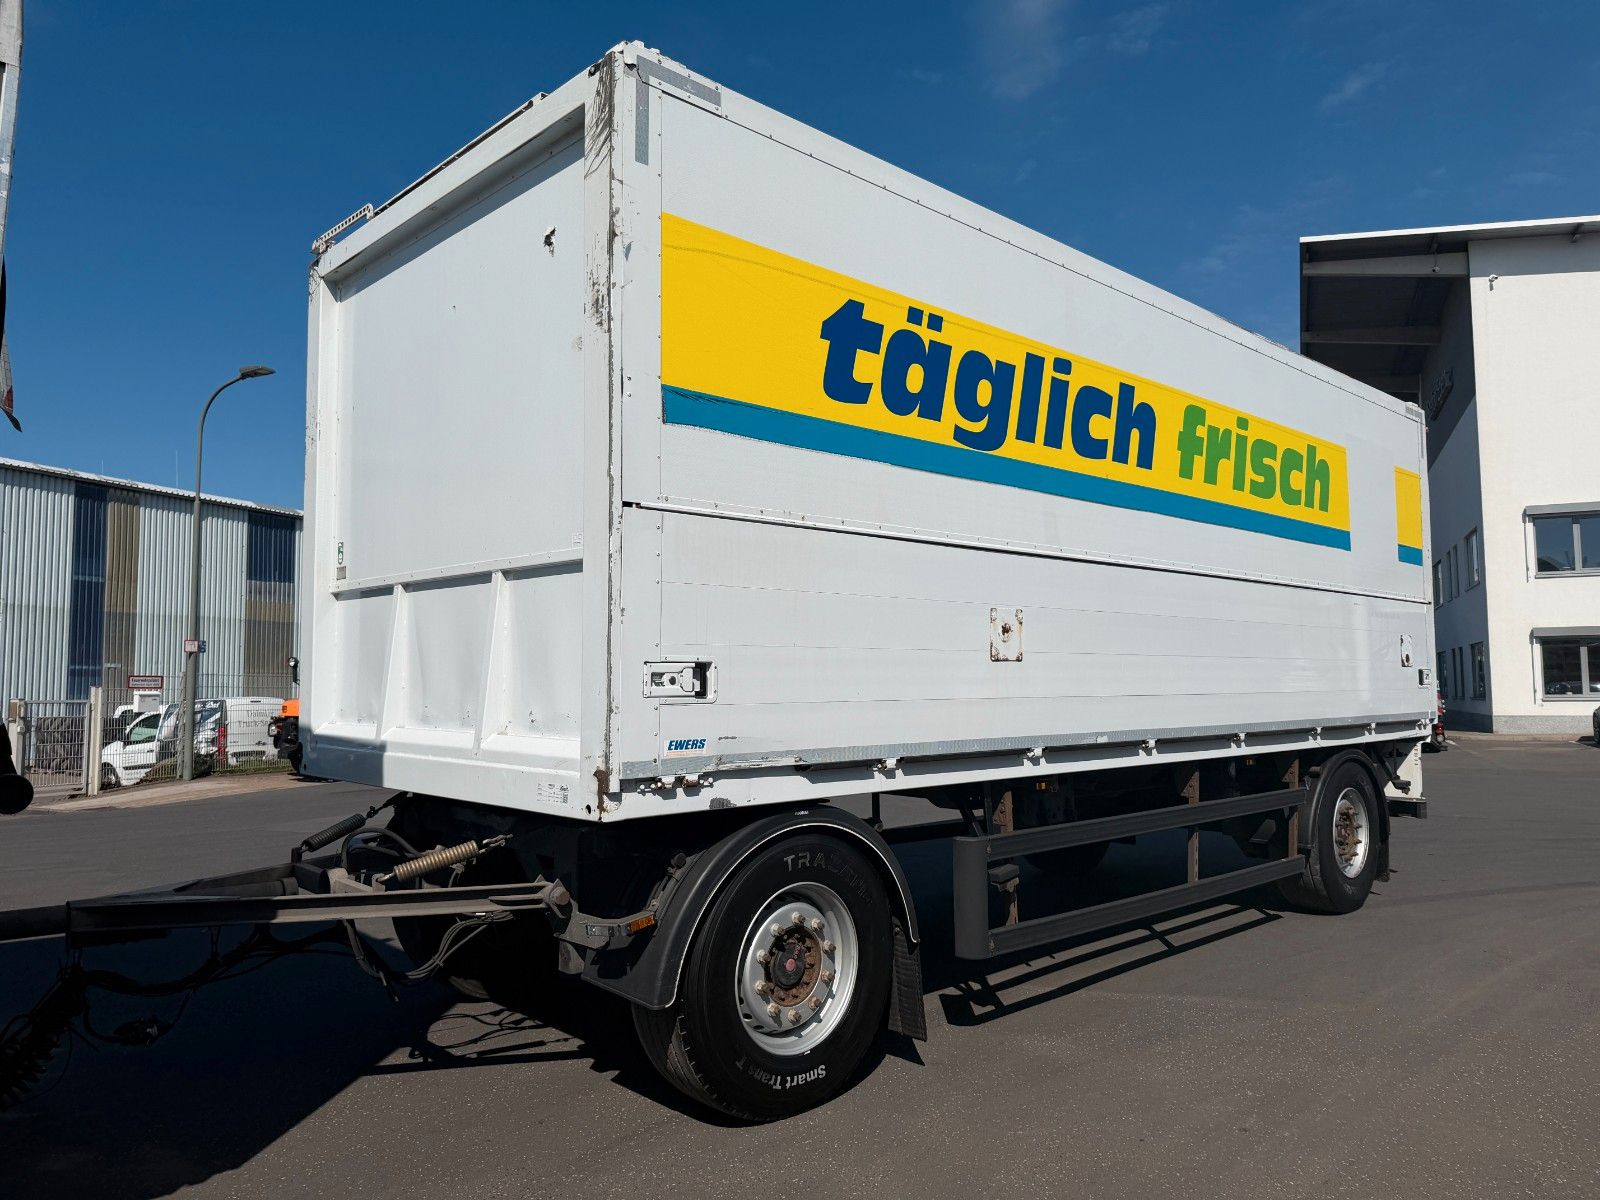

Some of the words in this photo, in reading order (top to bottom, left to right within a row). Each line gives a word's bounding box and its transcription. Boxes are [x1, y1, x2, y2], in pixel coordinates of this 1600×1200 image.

[820, 298, 1157, 470] täglich
[1176, 404, 1331, 513] frisch
[667, 739, 707, 751] EWERS
[785, 1064, 827, 1090] Smart
